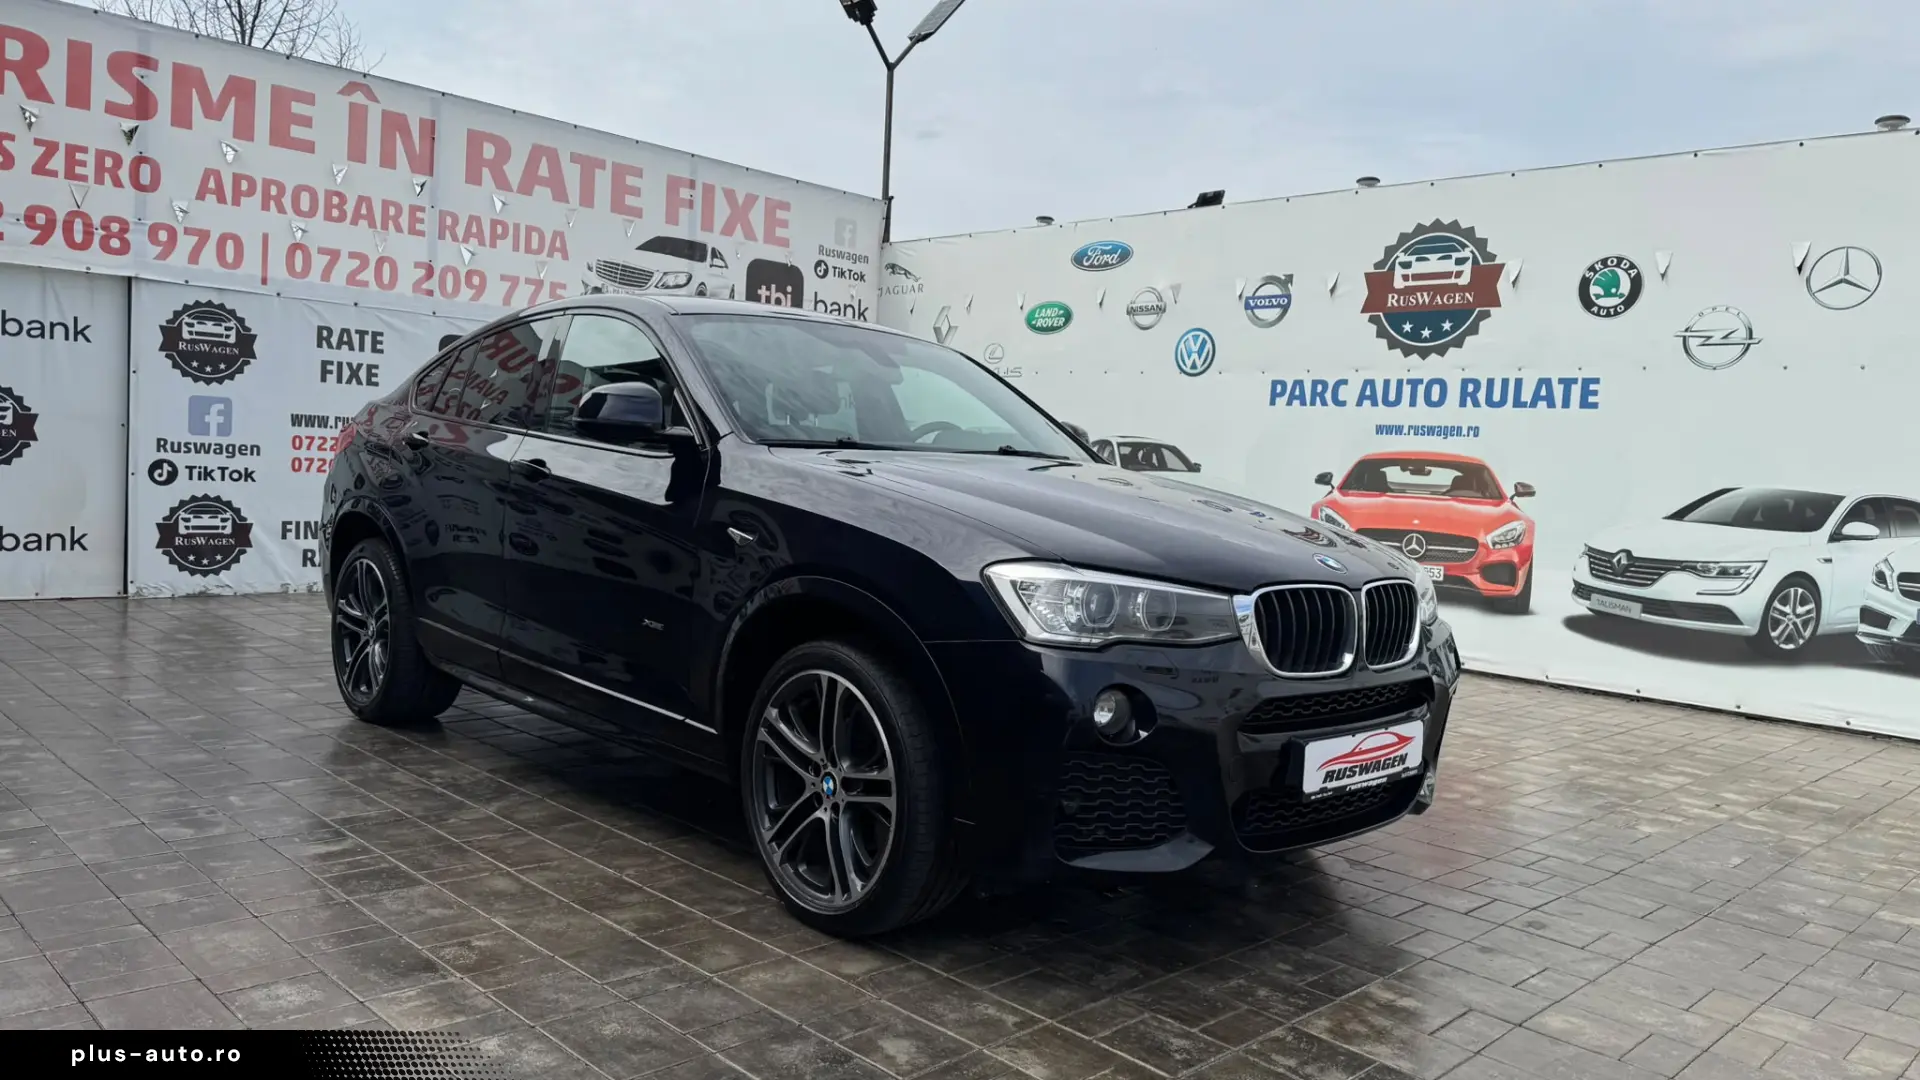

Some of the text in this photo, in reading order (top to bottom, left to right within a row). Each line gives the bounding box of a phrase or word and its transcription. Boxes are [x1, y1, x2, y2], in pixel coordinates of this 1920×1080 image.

[0, 24, 791, 248] RISME ÎN RATE FIXE
[31, 137, 162, 194] ZERO
[195, 167, 427, 238] APROBARE
[438, 209, 569, 260] RAPIDA
[24, 204, 131, 256] 908
[147, 221, 245, 271] 970
[285, 241, 399, 291] 0720
[412, 261, 487, 302] 209
[818, 244, 869, 265] Ruswagen
[1083, 245, 1122, 266] Ford
[832, 266, 866, 283] TikTok
[1585, 257, 1639, 279] SKODA
[878, 283, 925, 297] JAGUAR
[814, 291, 869, 322] bank
[1130, 304, 1162, 313] NISSAN
[1248, 297, 1288, 307] VOLVO
[1590, 304, 1625, 316] AUTO
[1035, 308, 1058, 318] LAND
[1036, 317, 1065, 328] ROVER
[1, 309, 92, 343] bank
[316, 325, 384, 355] RATE
[320, 360, 379, 387] FIXE
[1269, 377, 1600, 409] PARC AUTO RULATE
[1375, 423, 1480, 440] www.ruswagen.ro
[156, 437, 261, 460] Ruswagen
[185, 464, 256, 483] TikTok
[0, 526, 88, 551] bank
[1597, 599, 1631, 614] TALISMAN
[1322, 752, 1408, 784] RUSWAGEN
